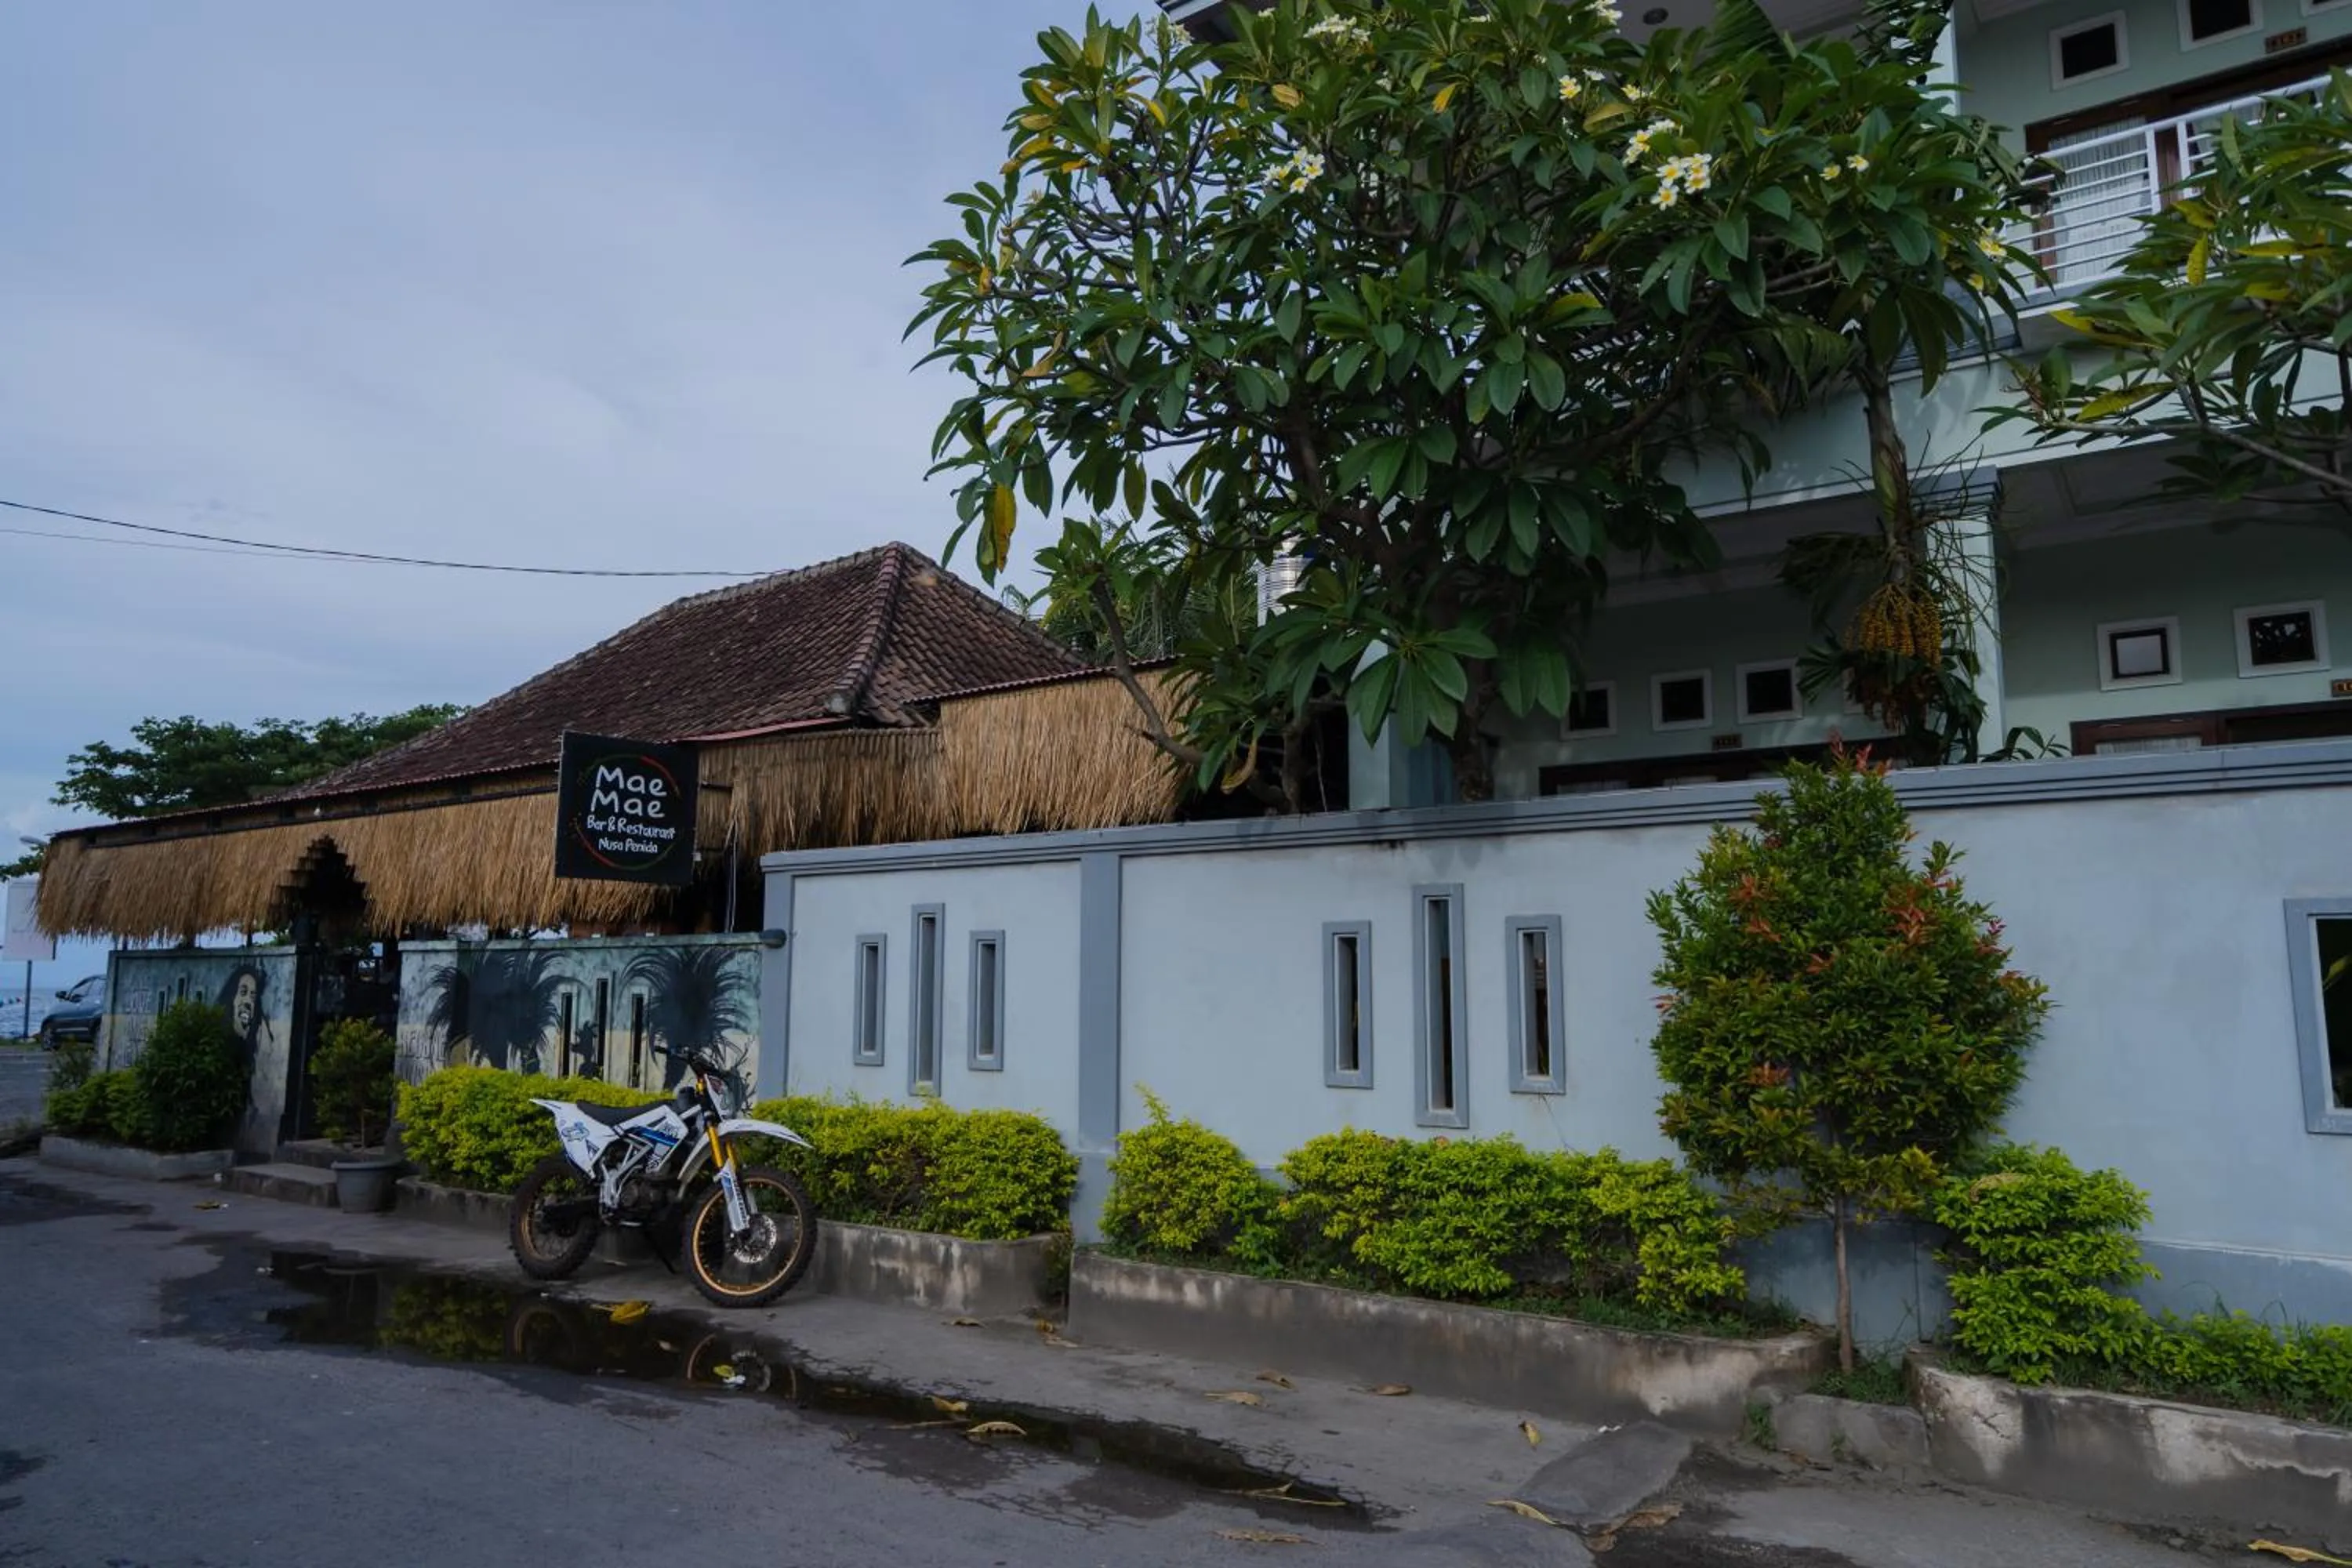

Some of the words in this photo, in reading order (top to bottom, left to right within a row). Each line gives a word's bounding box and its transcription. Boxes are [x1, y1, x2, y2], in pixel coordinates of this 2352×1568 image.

[596, 765, 666, 797] Mae
[590, 789, 665, 818] Mae
[598, 837, 624, 851] Nusa
[625, 838, 658, 854] Penida
